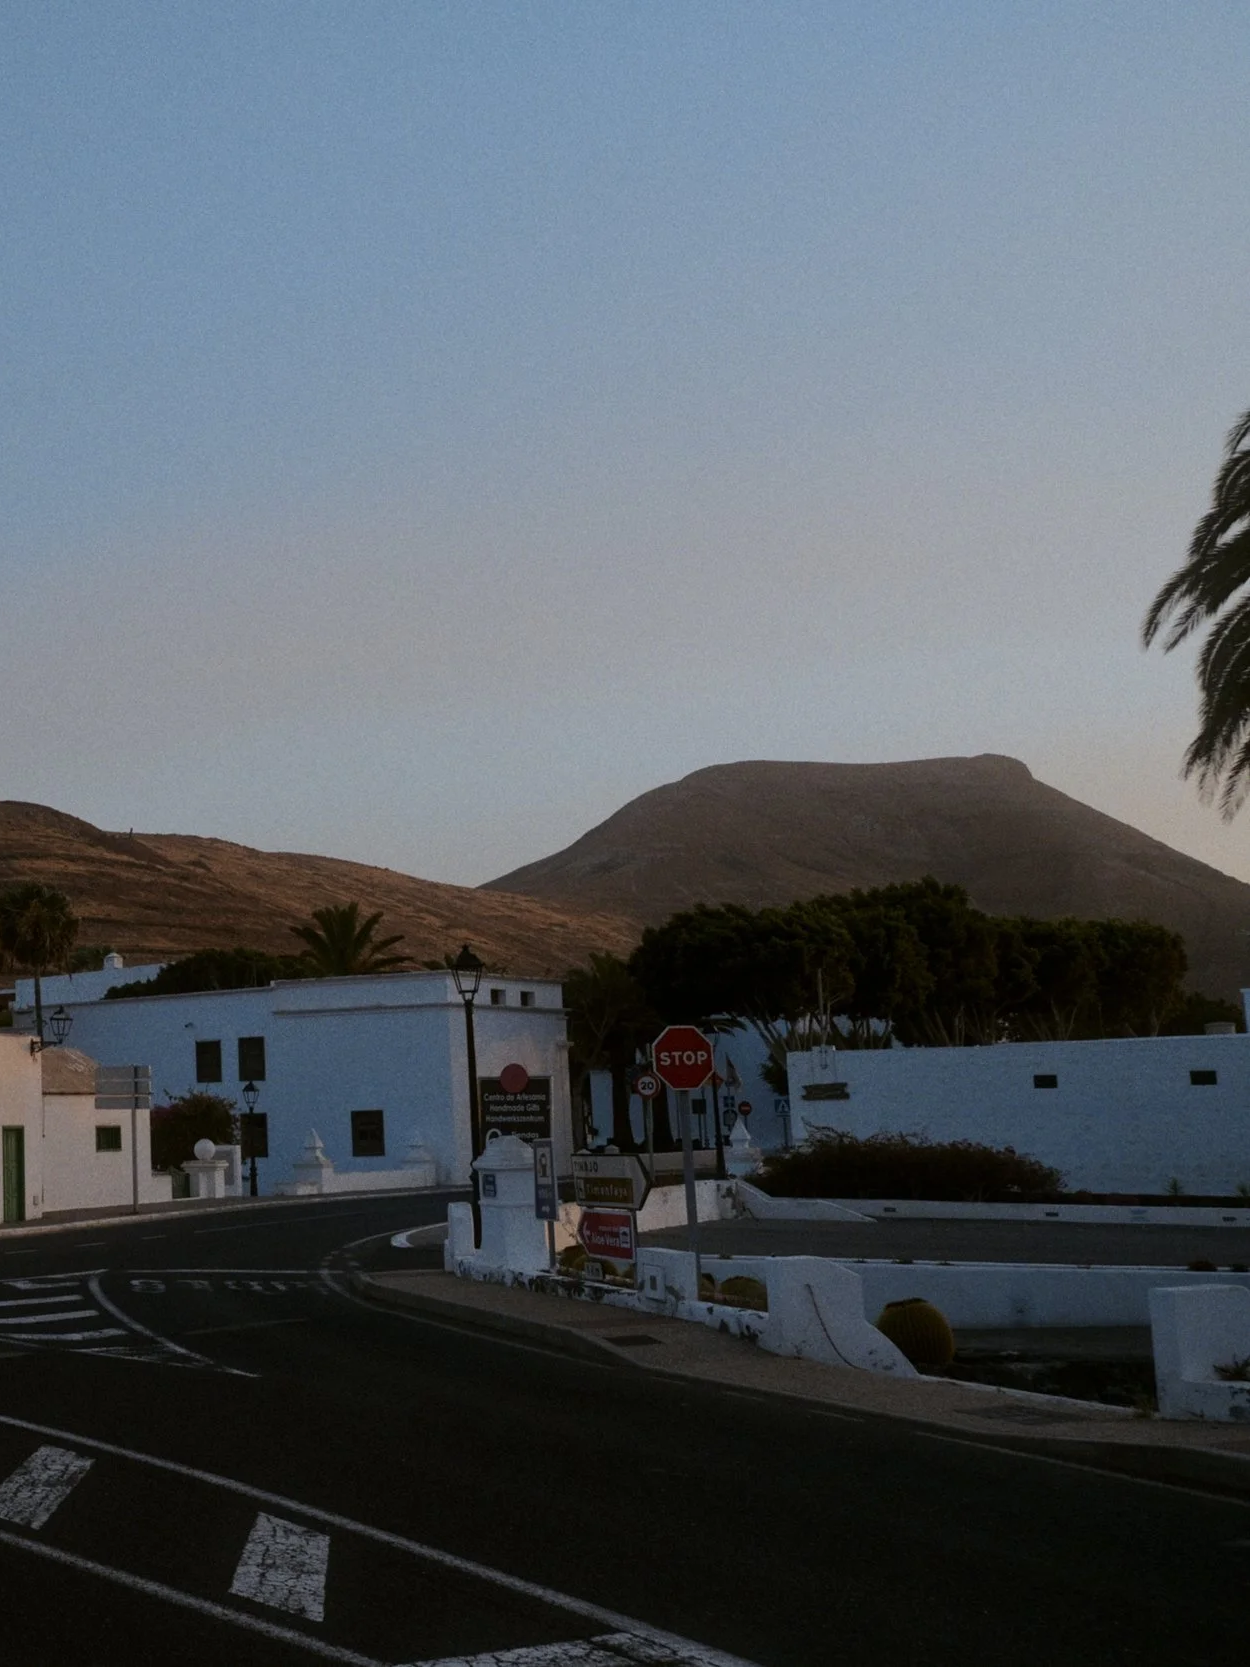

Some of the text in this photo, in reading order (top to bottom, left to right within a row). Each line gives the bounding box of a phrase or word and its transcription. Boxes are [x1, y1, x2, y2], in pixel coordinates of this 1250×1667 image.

[659, 1050, 708, 1066] STOP
[640, 1081, 654, 1090] 20
[483, 1092, 505, 1101] Centro
[506, 1093, 515, 1101] de
[490, 1104, 540, 1112] Handmade Gifts
